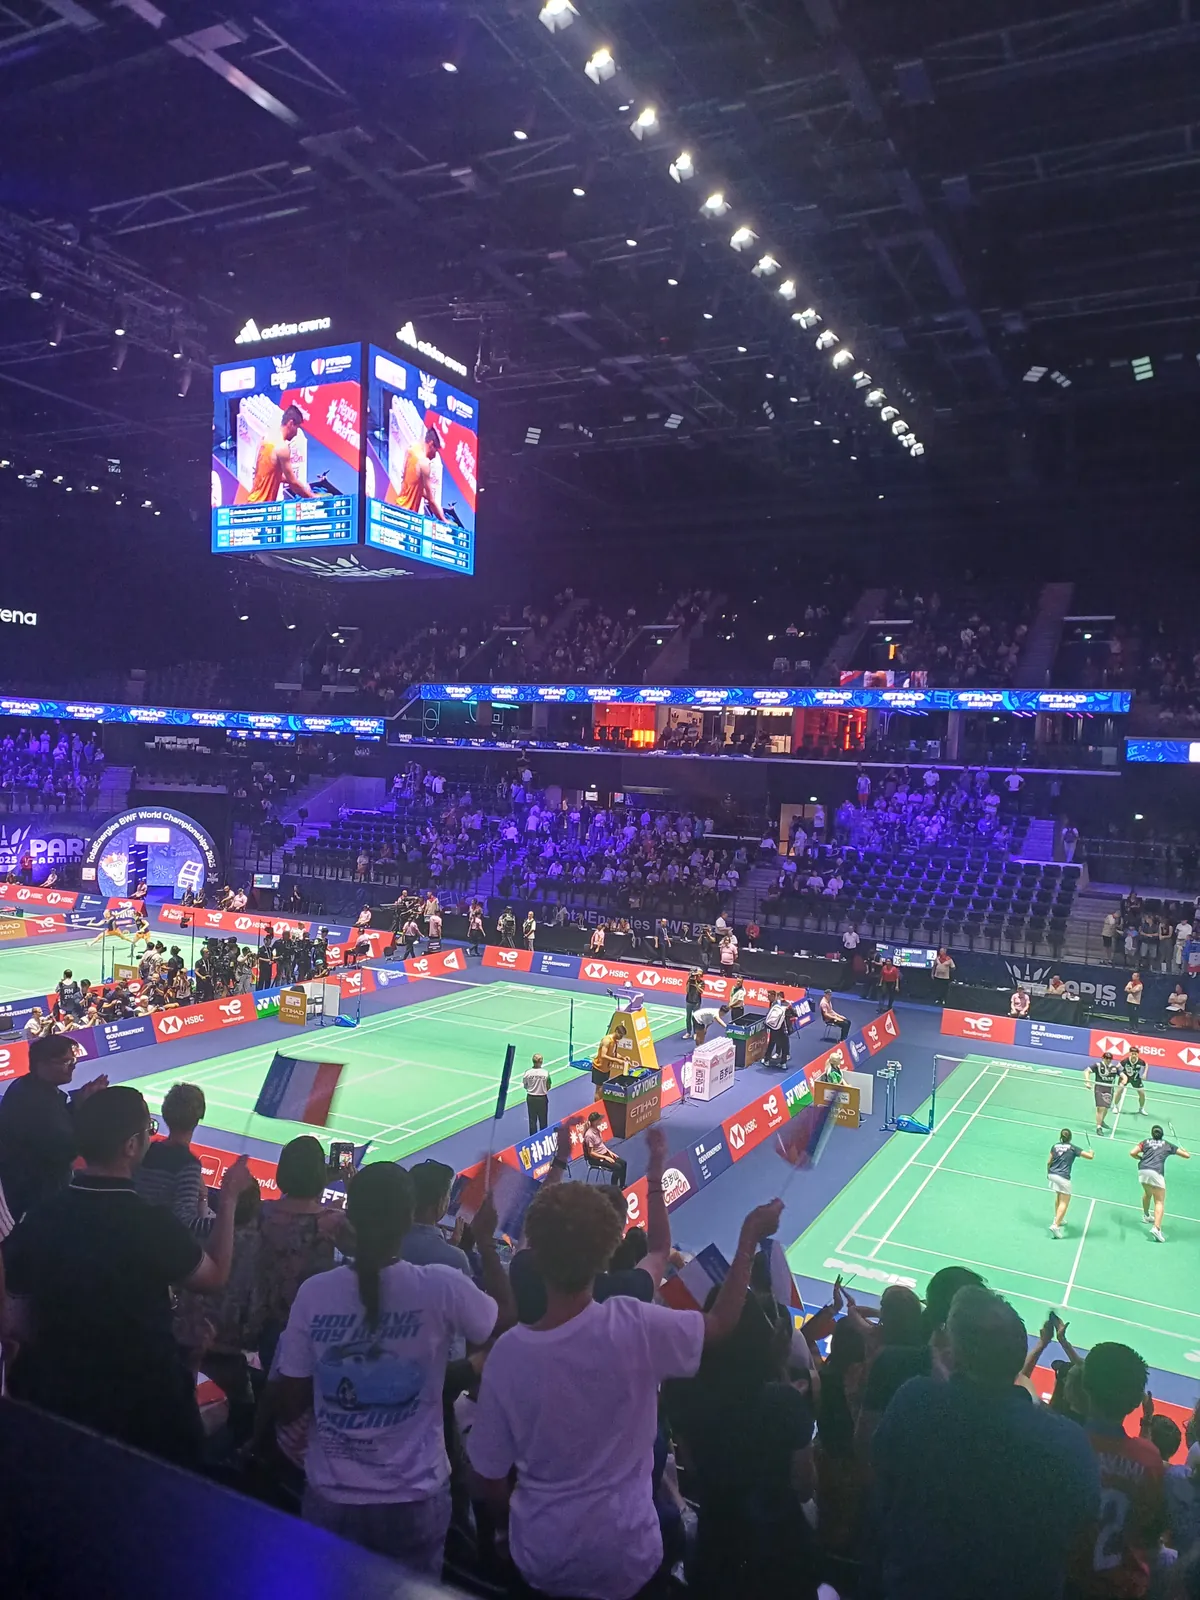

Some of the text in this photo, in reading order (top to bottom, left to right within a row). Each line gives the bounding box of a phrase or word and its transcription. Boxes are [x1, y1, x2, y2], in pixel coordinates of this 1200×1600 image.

[0, 608, 37, 625] ena
[491, 687, 518, 695] ETIHAD
[588, 688, 617, 696] ETIHAD
[639, 689, 671, 697] ETIHAD
[695, 690, 728, 698] ETIHAD
[753, 691, 789, 700] ETIHAD
[814, 691, 852, 700] ETIHAD
[882, 692, 926, 701] ETIHAD
[958, 693, 1003, 702] ETIHAD
[1039, 694, 1087, 704] ETIHAD
[1, 701, 40, 711] ETIHAD
[66, 705, 104, 715] ETIHAD
[130, 709, 166, 718] ETIHAD
[192, 712, 225, 721] ETIHAD
[248, 715, 281, 724] ETIHAD
[304, 718, 331, 726] ETIHAD
[350, 719, 378, 728] ETIHAD
[86, 811, 217, 868] TotalEnergies BWF World Championships 2025
[609, 969, 683, 986] HSBC HSBC
[281, 1006, 305, 1016] ETIHAD
[184, 1014, 205, 1026] HSBC
[106, 1027, 145, 1040] GOUVERNEMENT
[962, 1029, 992, 1038] TotalEnergies
[1030, 1031, 1075, 1041] GOUVERNEMENT
[1135, 1045, 1166, 1057] HSBC
[642, 1075, 659, 1093] YONEX
[661, 1078, 675, 1092] HSBC
[792, 1080, 810, 1101] YONEX
[630, 1096, 659, 1118] ETIHAD
[744, 1119, 758, 1135] HSBC
[698, 1142, 723, 1165] GOUVERNEMENT
[662, 1170, 680, 1189] 百岁山
[310, 1313, 357, 1328] YOU
[310, 1328, 347, 1342] MY
[1092, 1488, 1131, 1572] 2
